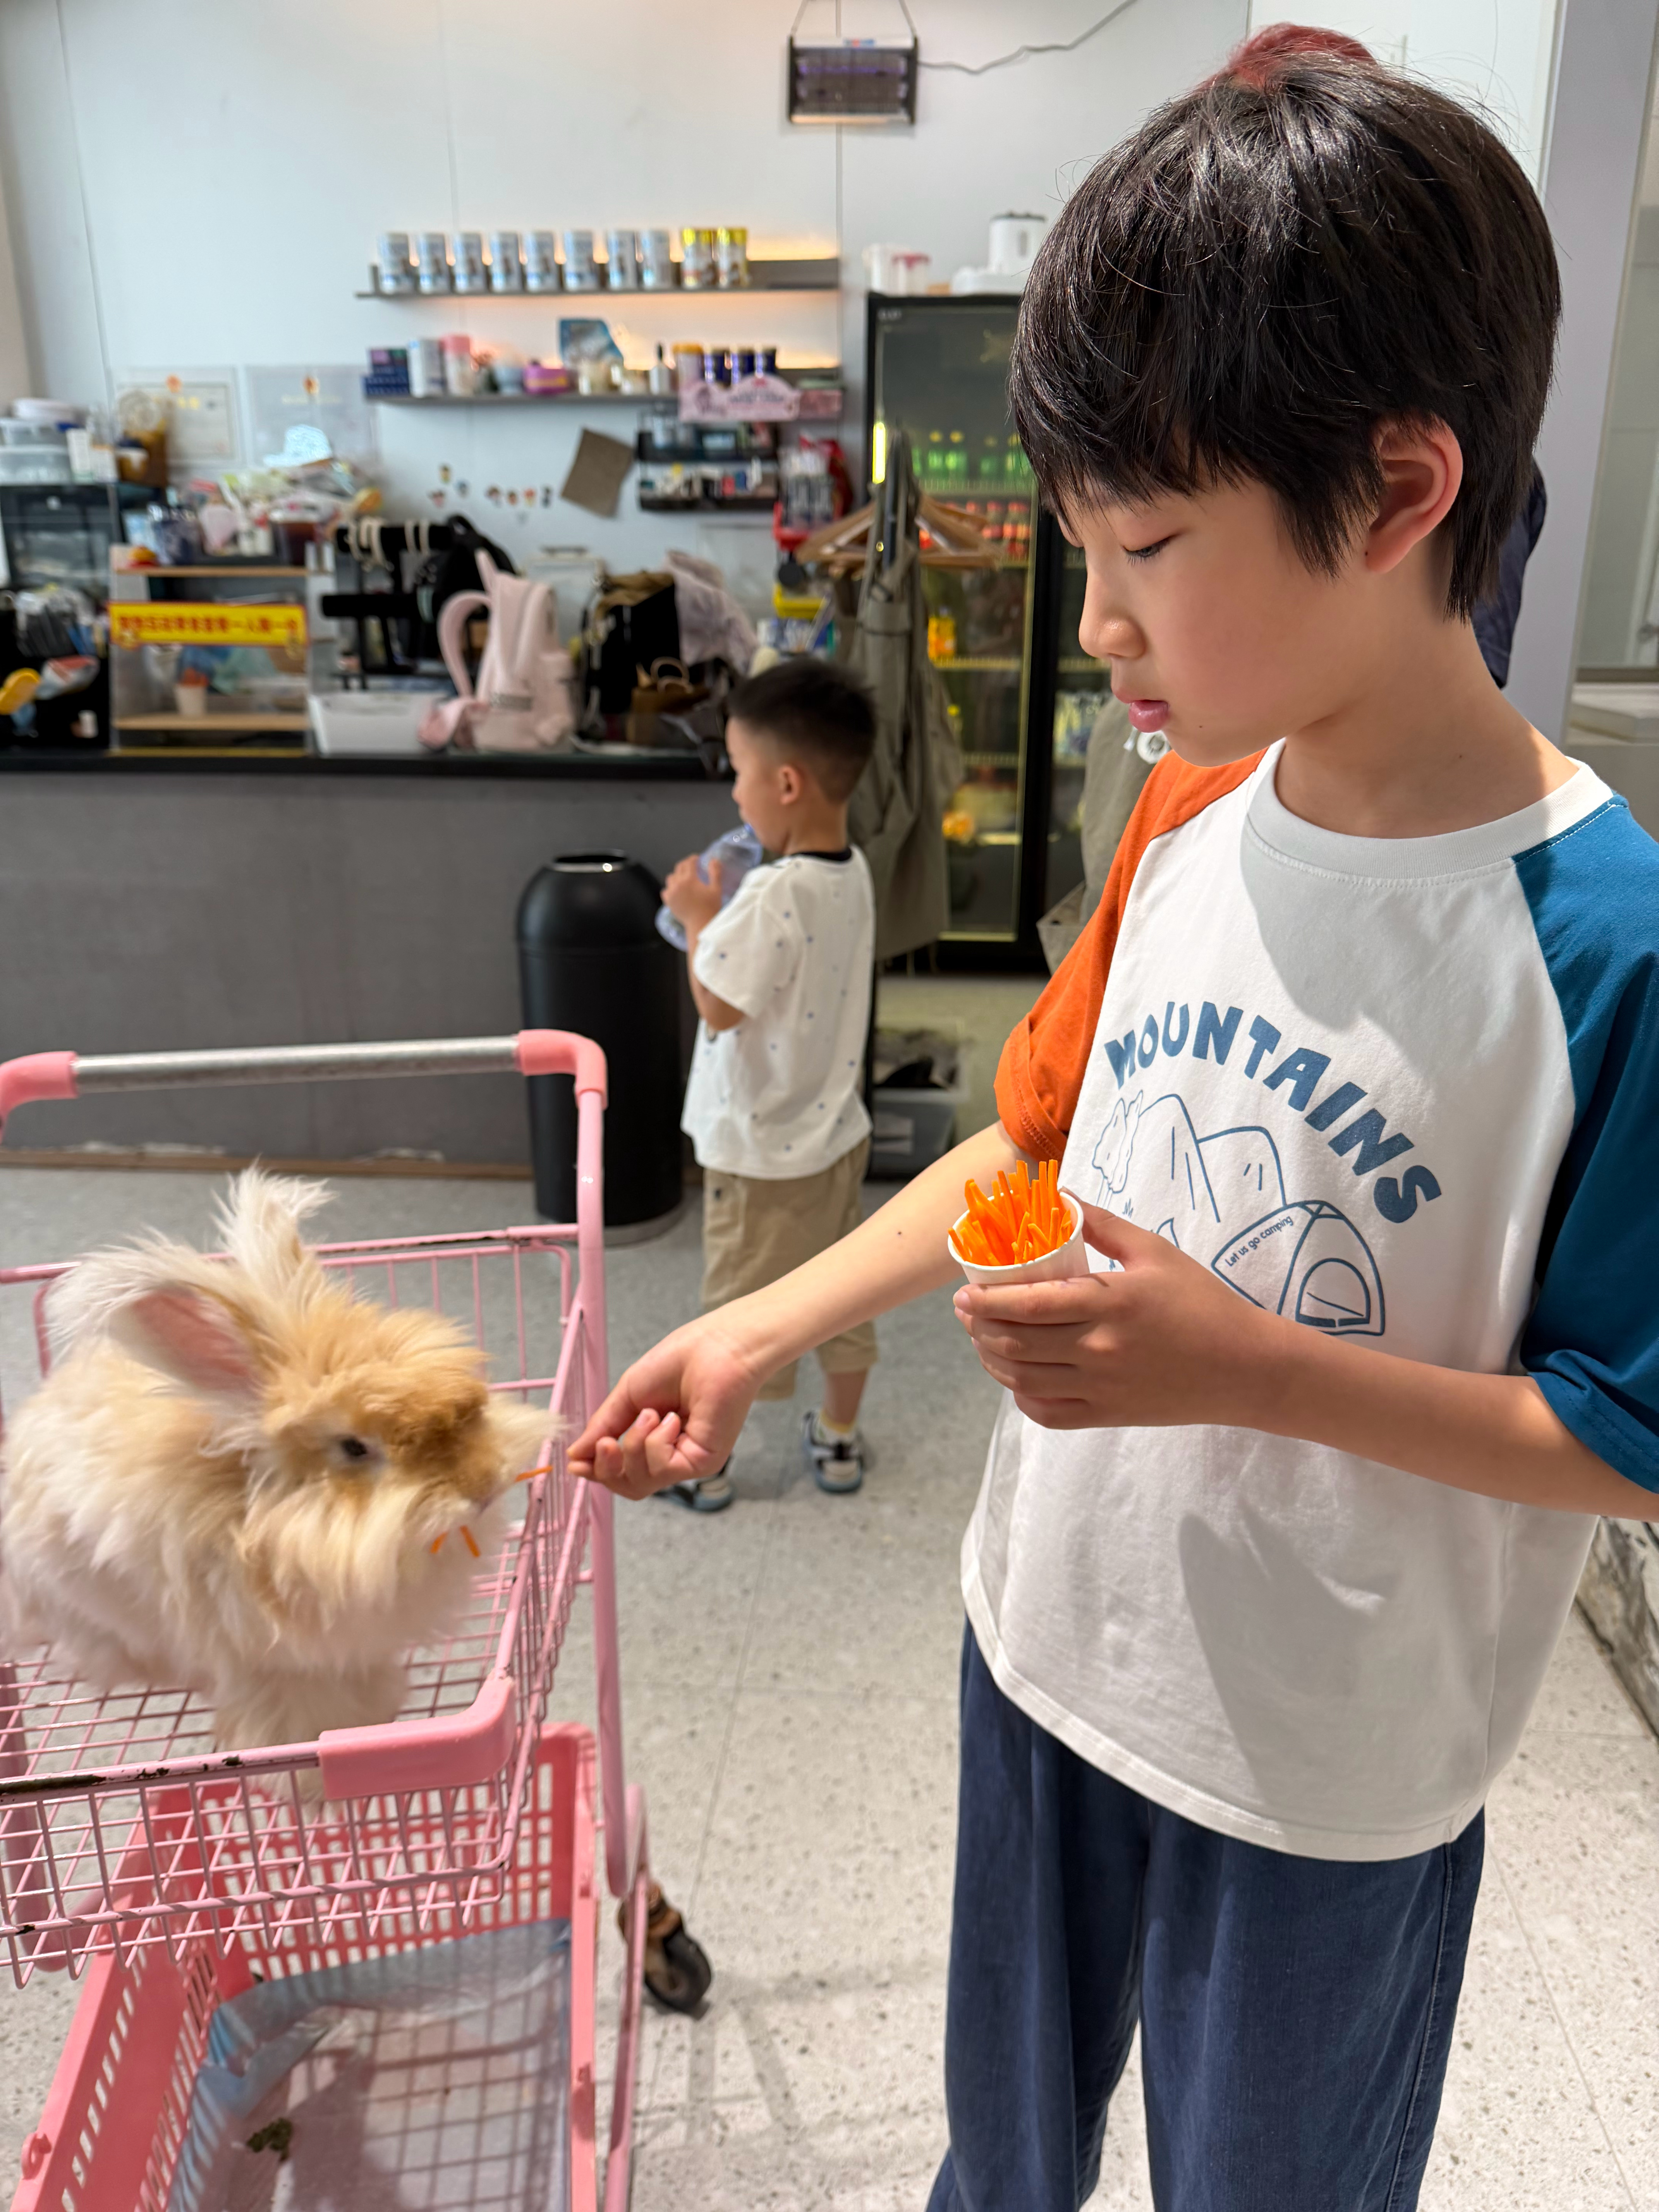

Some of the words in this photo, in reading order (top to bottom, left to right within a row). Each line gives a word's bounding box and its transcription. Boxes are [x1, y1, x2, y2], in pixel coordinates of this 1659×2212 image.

[1104, 1001, 1442, 1223] MOUNTAINS
[1224, 1253, 1240, 1266] Let
[1238, 1246, 1249, 1255] us
[1248, 1237, 1260, 1250] go
[1260, 1216, 1293, 1239] camping
